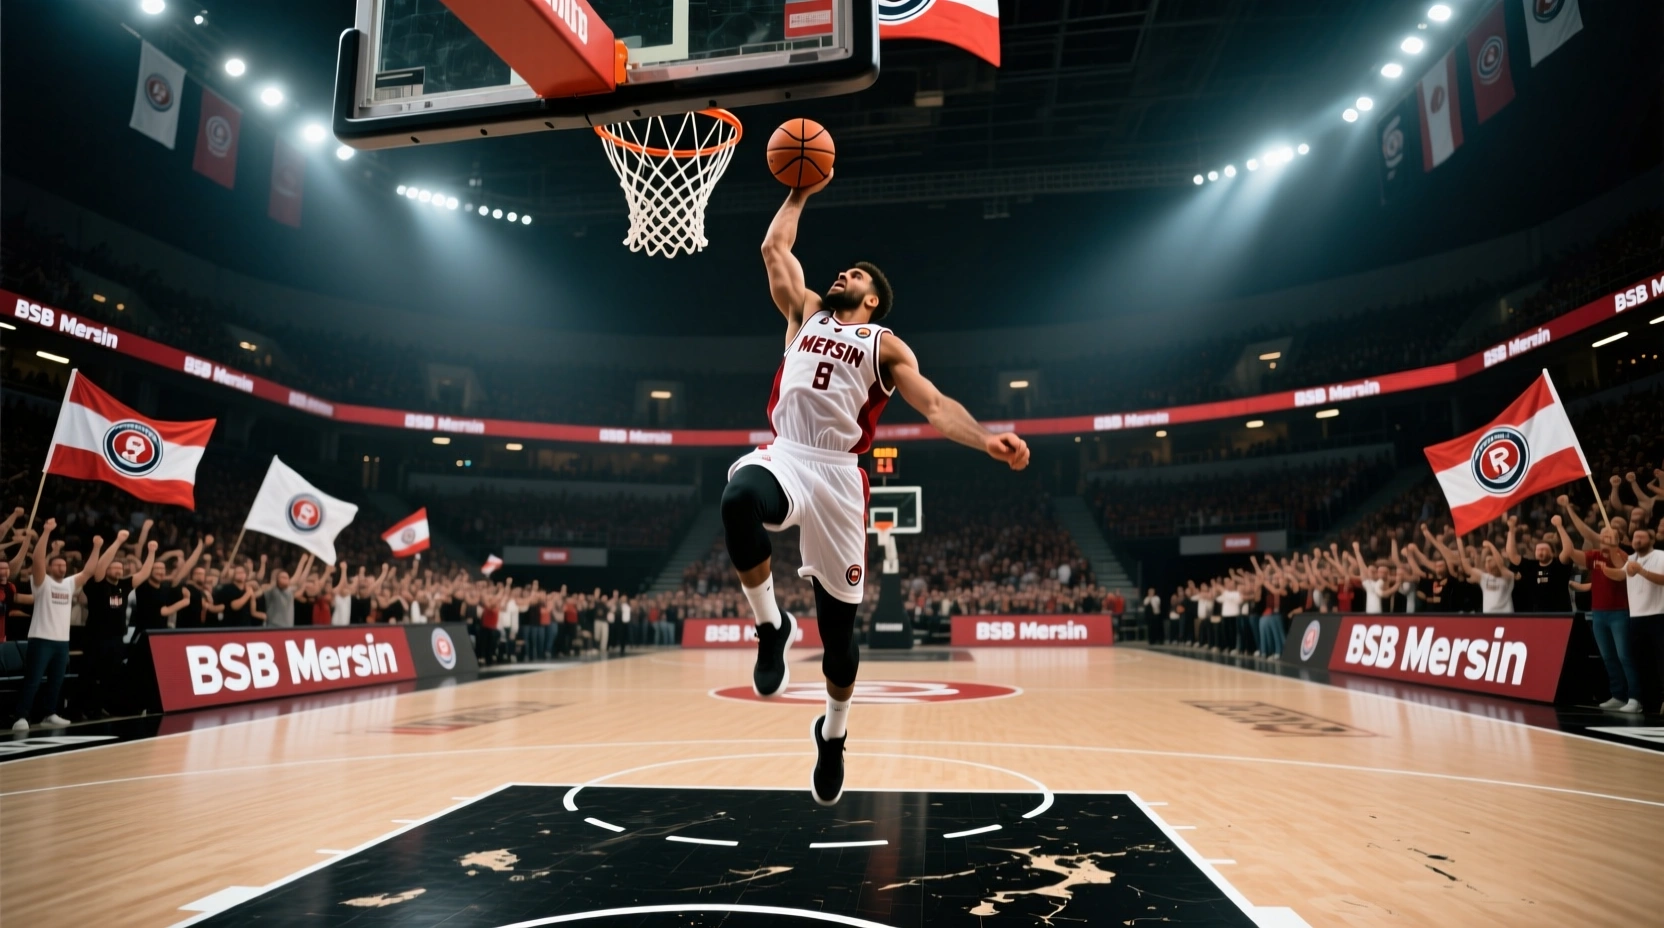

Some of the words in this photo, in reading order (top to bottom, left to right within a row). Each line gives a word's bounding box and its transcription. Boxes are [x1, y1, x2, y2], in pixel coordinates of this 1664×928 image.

[15, 298, 54, 327] BSB
[59, 313, 118, 349] Mersin
[1614, 284, 1648, 313] BSB
[976, 621, 1016, 641] BSB
[1019, 620, 1088, 641] Mersin
[1345, 624, 1400, 669] BSB
[1400, 626, 1528, 686] Mersin
[186, 641, 280, 696] BSB
[284, 633, 398, 685] Mersin
